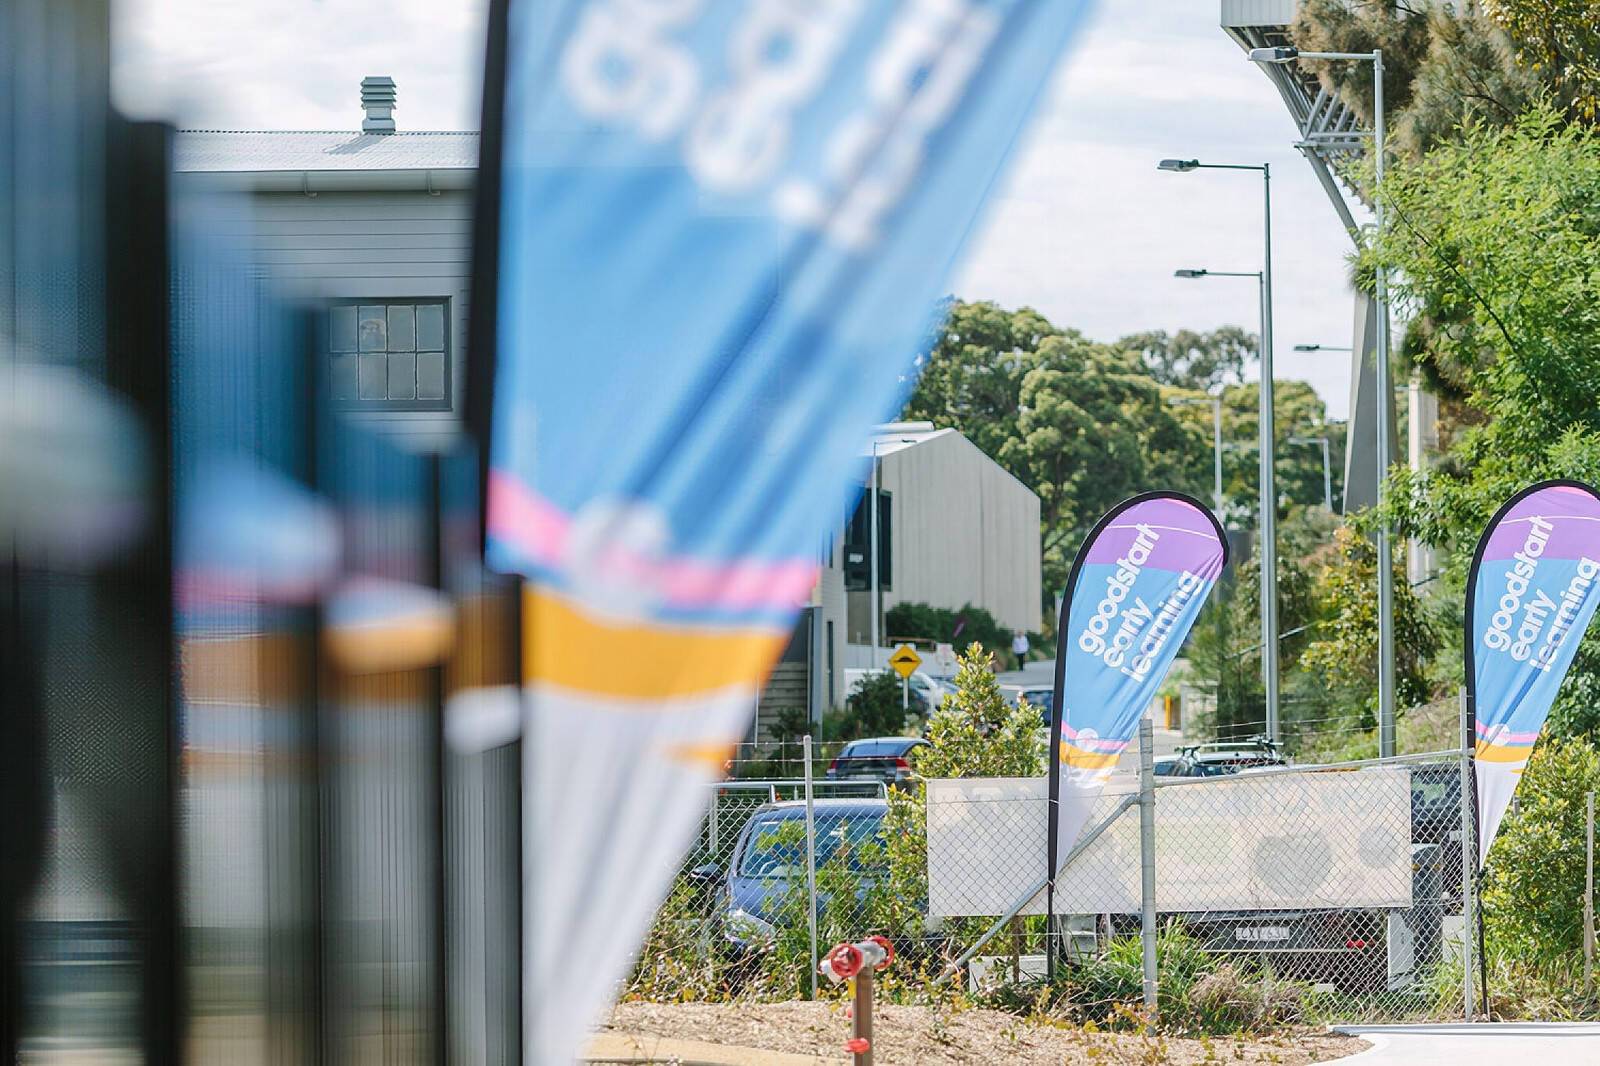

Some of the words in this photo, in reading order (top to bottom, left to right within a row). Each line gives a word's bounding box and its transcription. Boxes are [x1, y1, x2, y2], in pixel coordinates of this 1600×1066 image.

[1079, 523, 1160, 655] goodstart
[1104, 597, 1152, 667] early
[1484, 515, 1554, 651] goodstart
[1511, 588, 1556, 661] early
